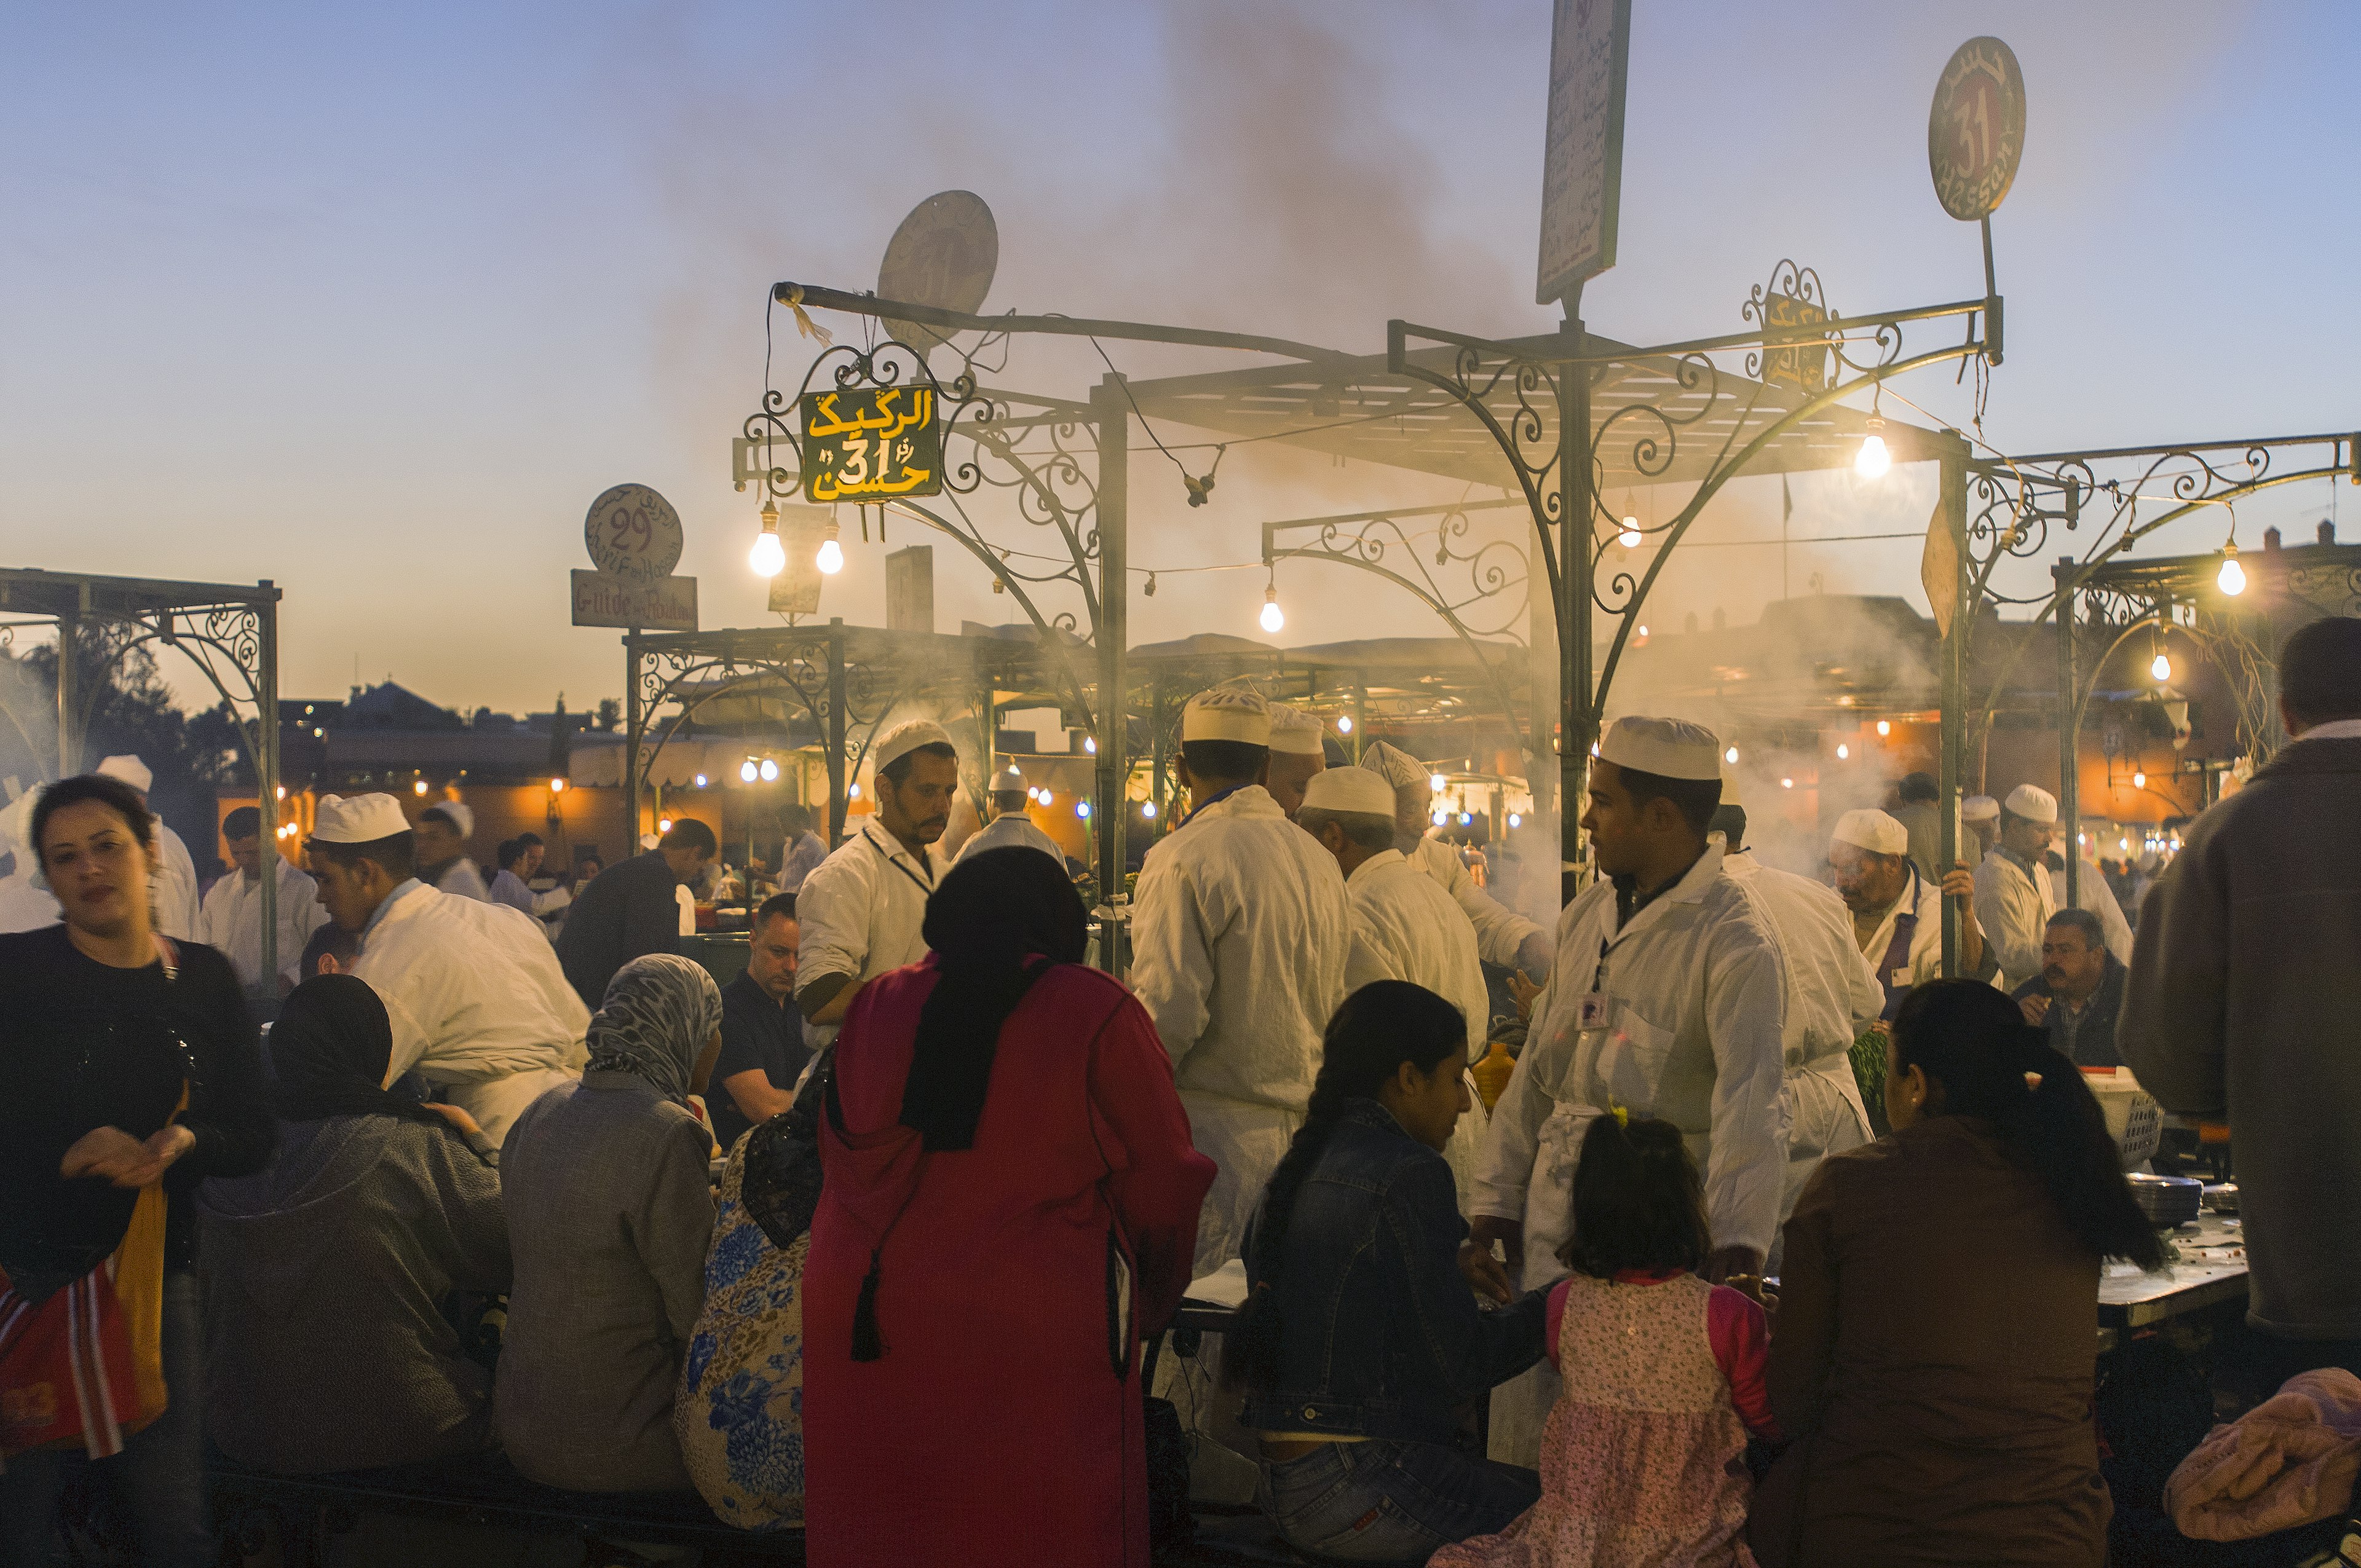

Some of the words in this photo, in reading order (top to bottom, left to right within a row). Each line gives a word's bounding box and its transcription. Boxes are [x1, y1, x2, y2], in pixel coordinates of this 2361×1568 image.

[1953, 86, 1990, 178] 31
[813, 465, 931, 500] حسن
[838, 439, 890, 484] 31
[610, 506, 652, 553] 29
